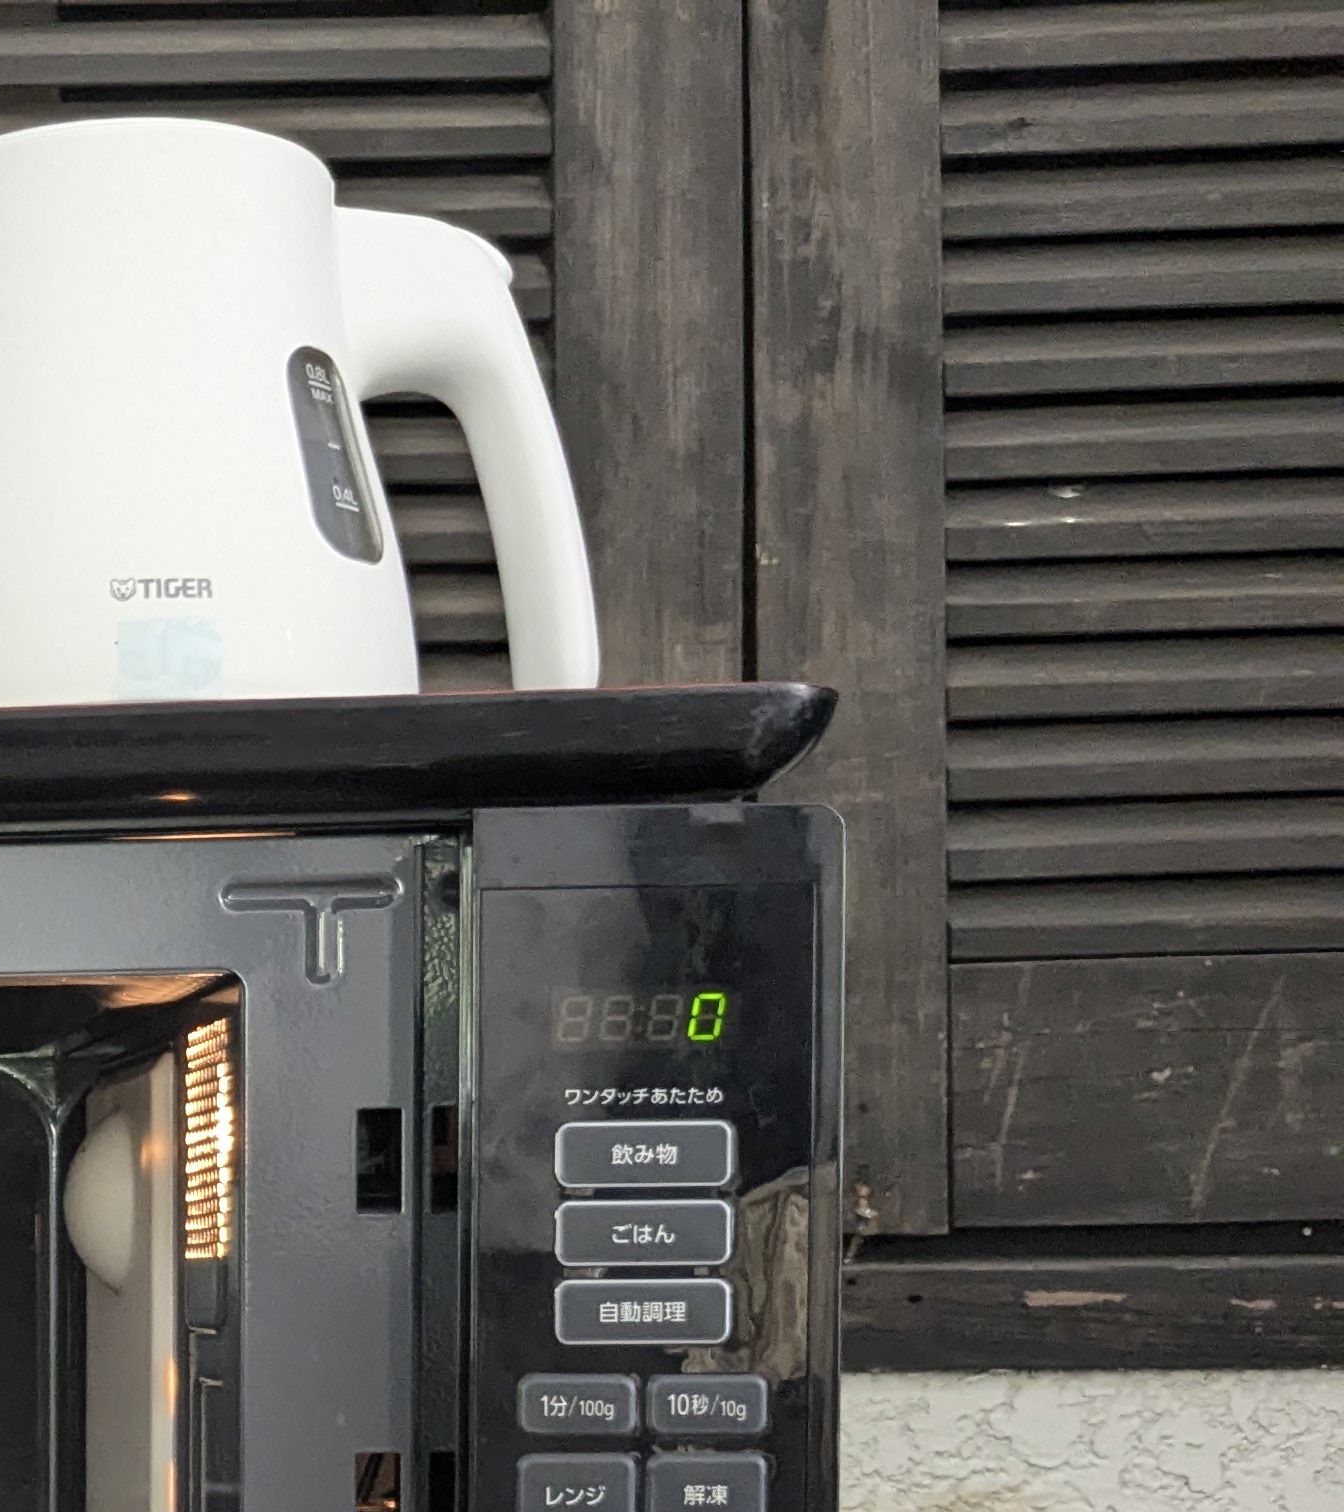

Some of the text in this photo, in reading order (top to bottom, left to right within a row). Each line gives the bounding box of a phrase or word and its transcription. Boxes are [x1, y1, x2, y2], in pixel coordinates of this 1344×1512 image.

[305, 362, 330, 385] 0.8L
[332, 485, 358, 506] 0.4L
[137, 577, 213, 599] TIGER
[687, 992, 726, 1041] 0
[564, 1087, 724, 1105] ワンタッチあたため
[611, 1143, 679, 1166] 飲み物
[611, 1223, 676, 1244] ごはん
[599, 1301, 687, 1323] 自動調理
[540, 1395, 615, 1421] 1分/100g
[667, 1393, 747, 1422] 10秒/10g
[545, 1485, 606, 1506] レンジ
[683, 1484, 728, 1506] 解凍
